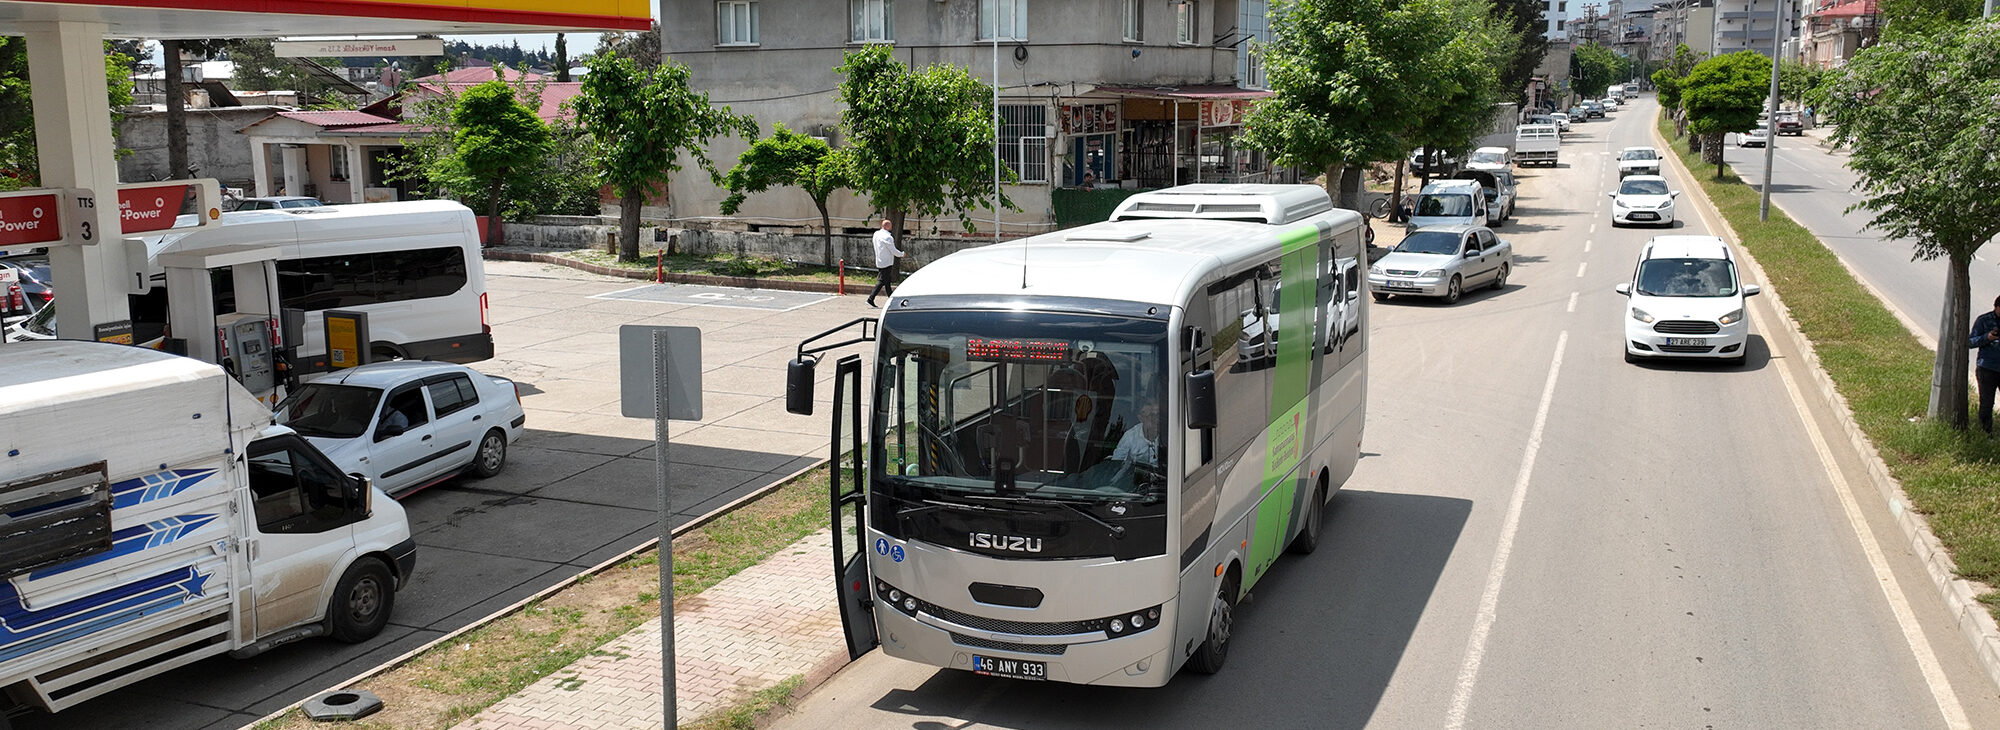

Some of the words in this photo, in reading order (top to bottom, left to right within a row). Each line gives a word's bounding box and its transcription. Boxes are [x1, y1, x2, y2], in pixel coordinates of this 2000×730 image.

[77, 197, 94, 208] TTS
[81, 221, 92, 241] 3
[136, 272, 143, 289] 1
[969, 532, 1042, 553] ISUZU
[980, 658, 993, 671] 46
[998, 660, 1017, 674] ANY
[1022, 662, 1043, 676] 933
